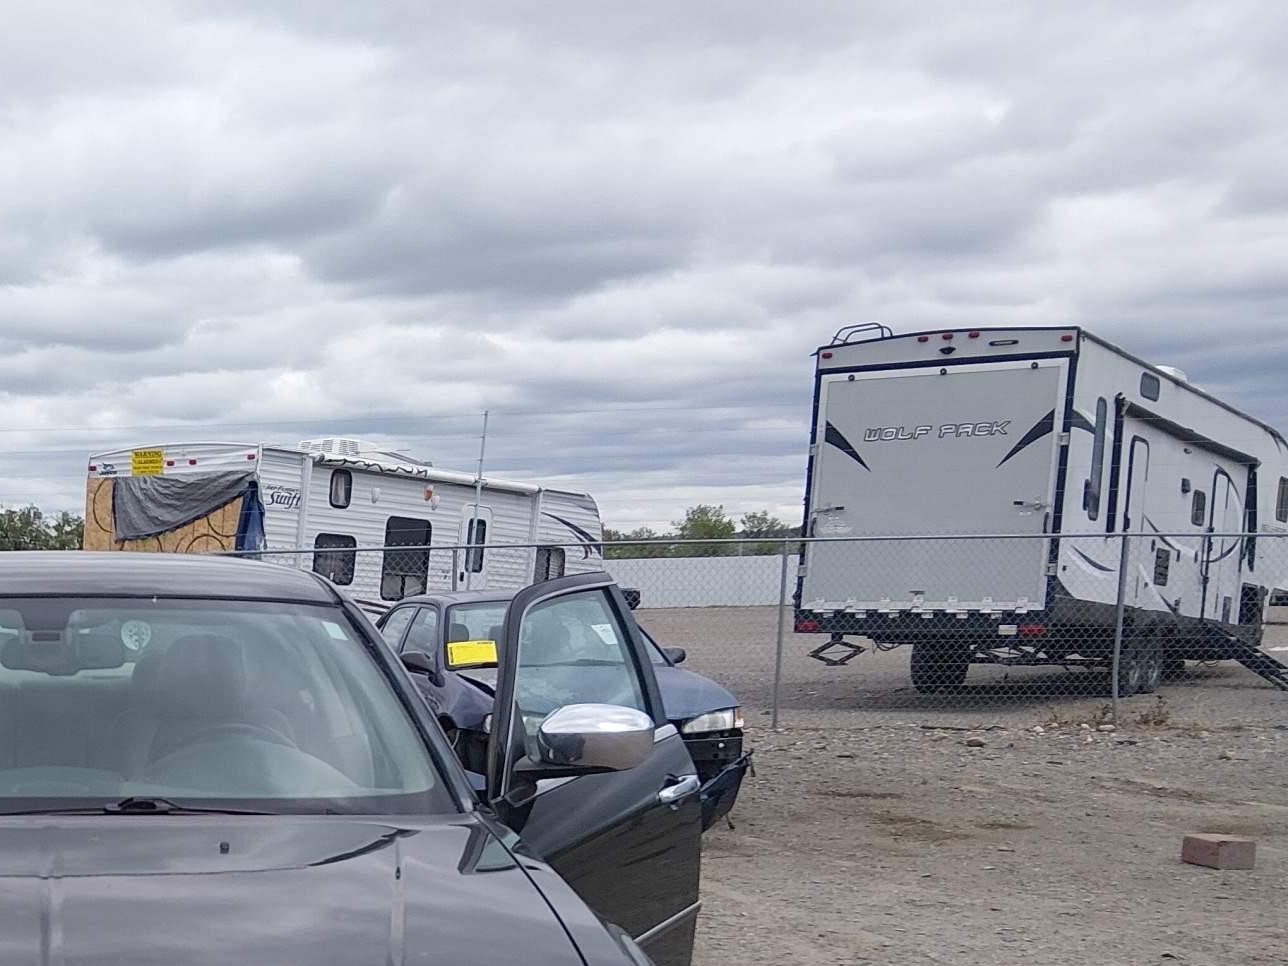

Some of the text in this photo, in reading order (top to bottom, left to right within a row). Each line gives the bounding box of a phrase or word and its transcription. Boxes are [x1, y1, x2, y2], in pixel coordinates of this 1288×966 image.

[864, 420, 1011, 442] WOLF PACK
[265, 491, 301, 509] Swift
